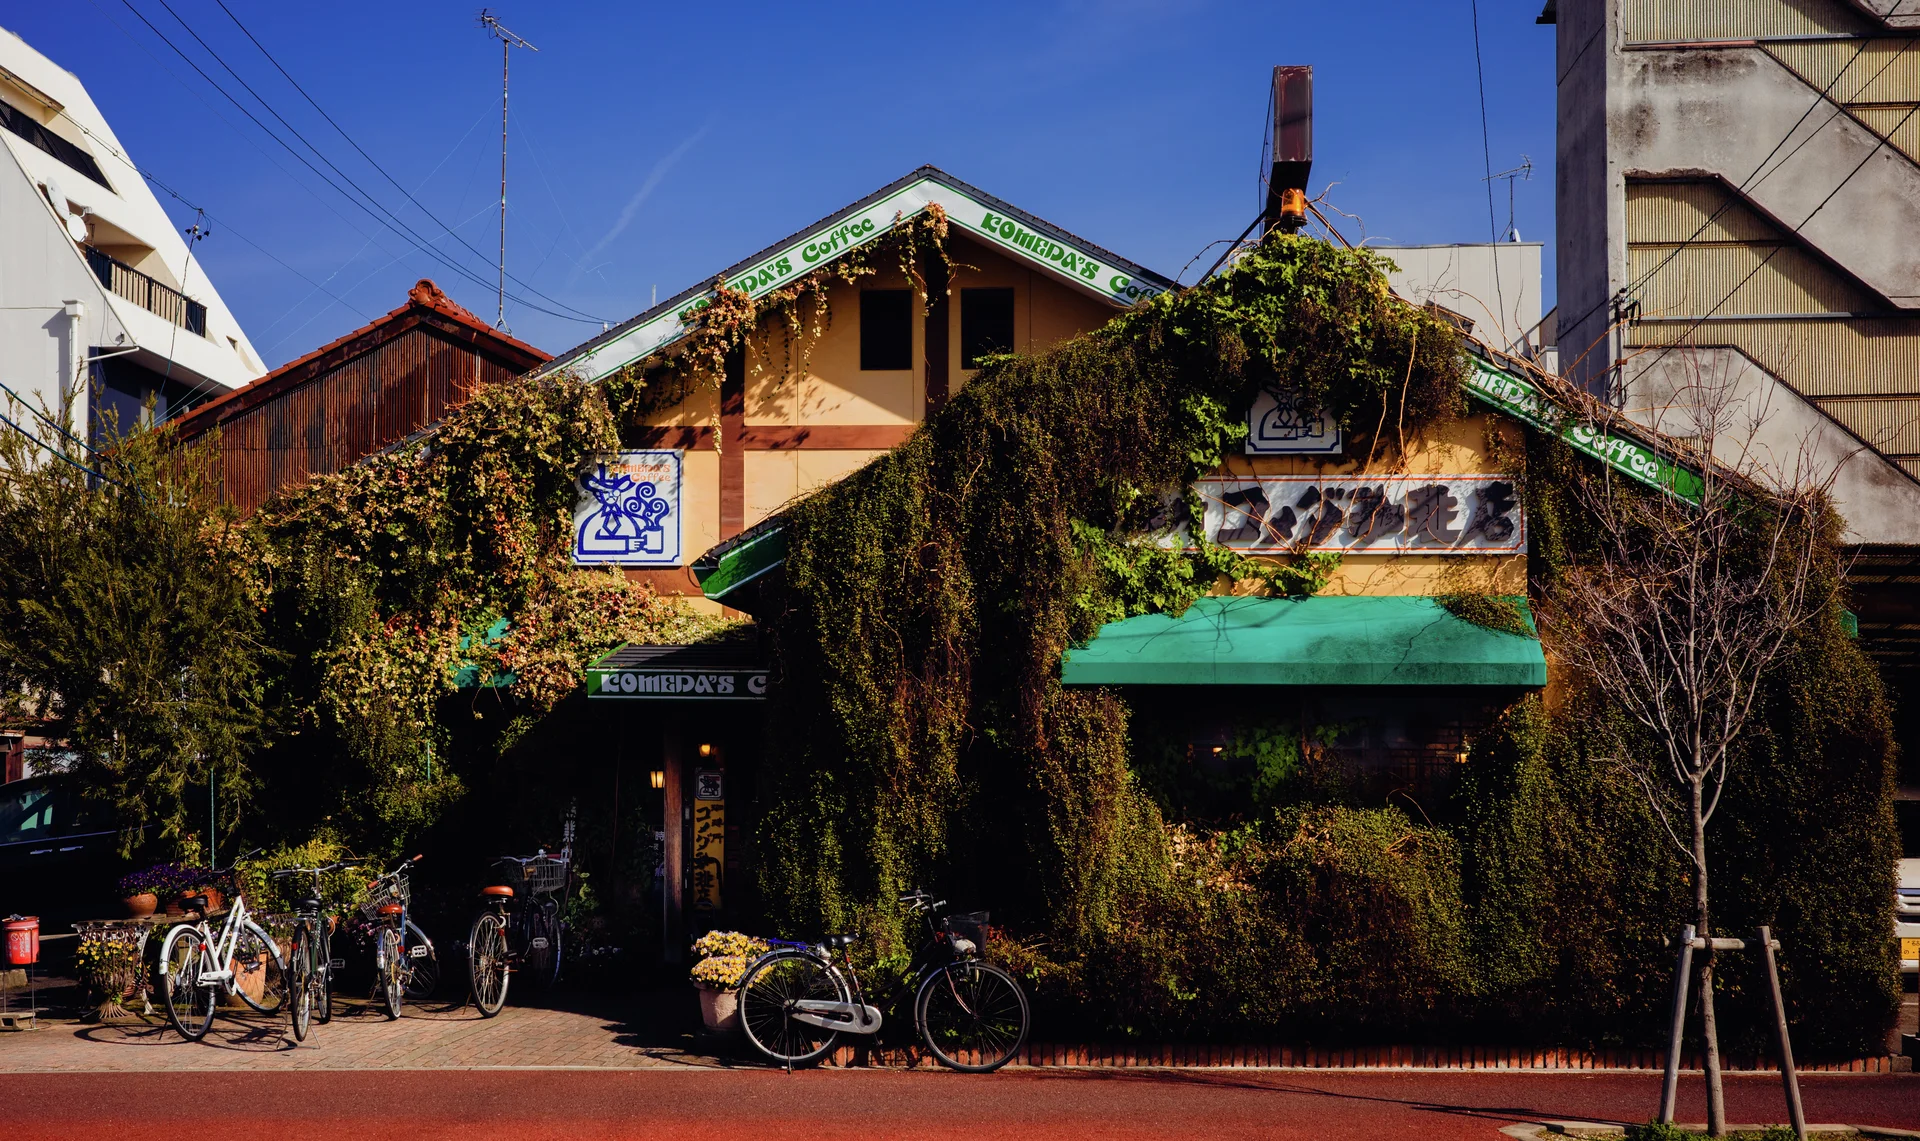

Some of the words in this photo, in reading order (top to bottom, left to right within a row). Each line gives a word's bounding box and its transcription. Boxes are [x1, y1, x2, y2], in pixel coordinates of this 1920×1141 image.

[801, 218, 875, 264] Coffee
[980, 212, 1101, 280] KOMEDA'S
[1109, 275, 1160, 302] Co
[1572, 423, 1659, 479] Coffee
[631, 472, 671, 482] Coffee
[601, 673, 735, 694] KOMEDA'S
